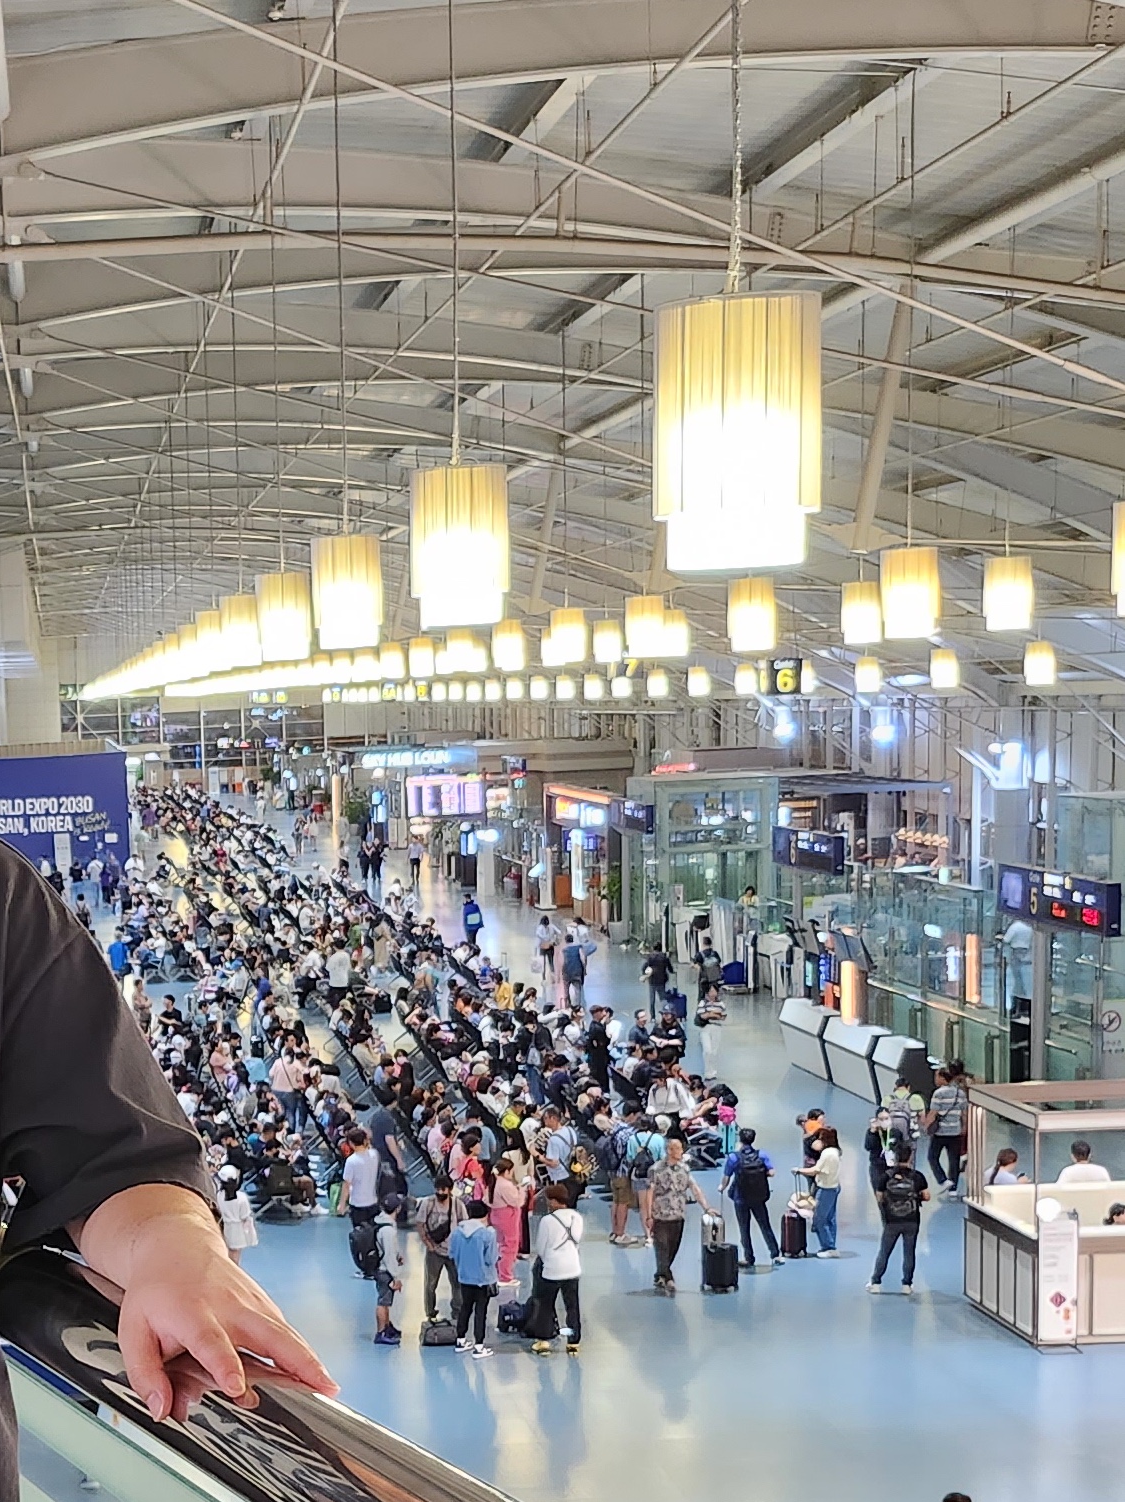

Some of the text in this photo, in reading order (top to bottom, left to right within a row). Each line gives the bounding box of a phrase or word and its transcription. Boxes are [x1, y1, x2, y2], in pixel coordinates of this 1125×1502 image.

[776, 669, 796, 693] 6
[361, 749, 452, 768] SKY HUB LOUN
[25, 797, 59, 815] EXPO
[60, 795, 93, 814] 2030
[30, 815, 73, 833] KOREA
[1030, 887, 1039, 915] 5
